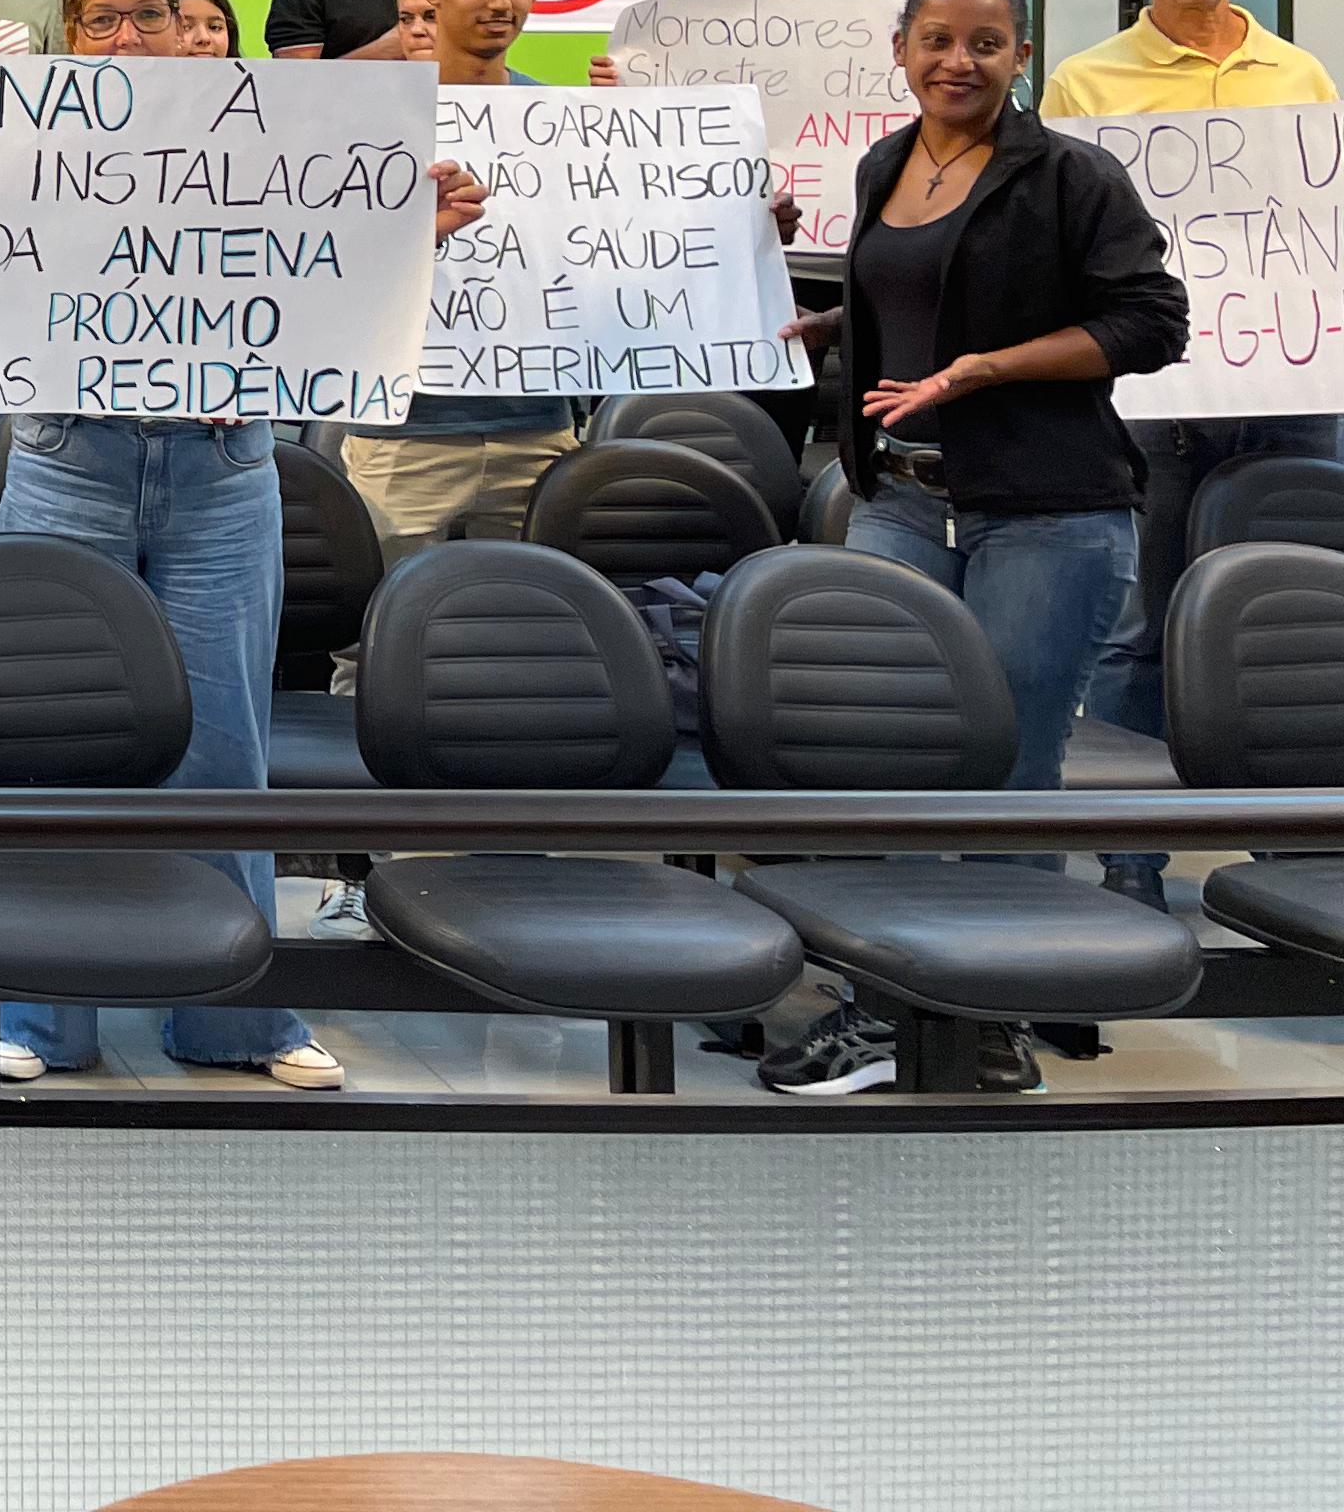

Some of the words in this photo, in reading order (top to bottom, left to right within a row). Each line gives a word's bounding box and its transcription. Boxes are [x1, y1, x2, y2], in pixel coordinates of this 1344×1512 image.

[210, 61, 266, 134] À
[627, 52, 789, 97] Silvestre
[523, 101, 740, 147] GARANTE
[465, 151, 541, 199] NÃO
[567, 152, 619, 201] HÁ
[640, 157, 771, 201] RISCO?
[99, 225, 344, 279] ANTENA
[562, 217, 719, 269] SAÚDE
[47, 276, 281, 349] PRÓXIMO
[426, 276, 506, 331] NÃO
[542, 273, 580, 331] É
[616, 287, 694, 332] UM
[78, 352, 413, 419] RESIDÊNCIAS
